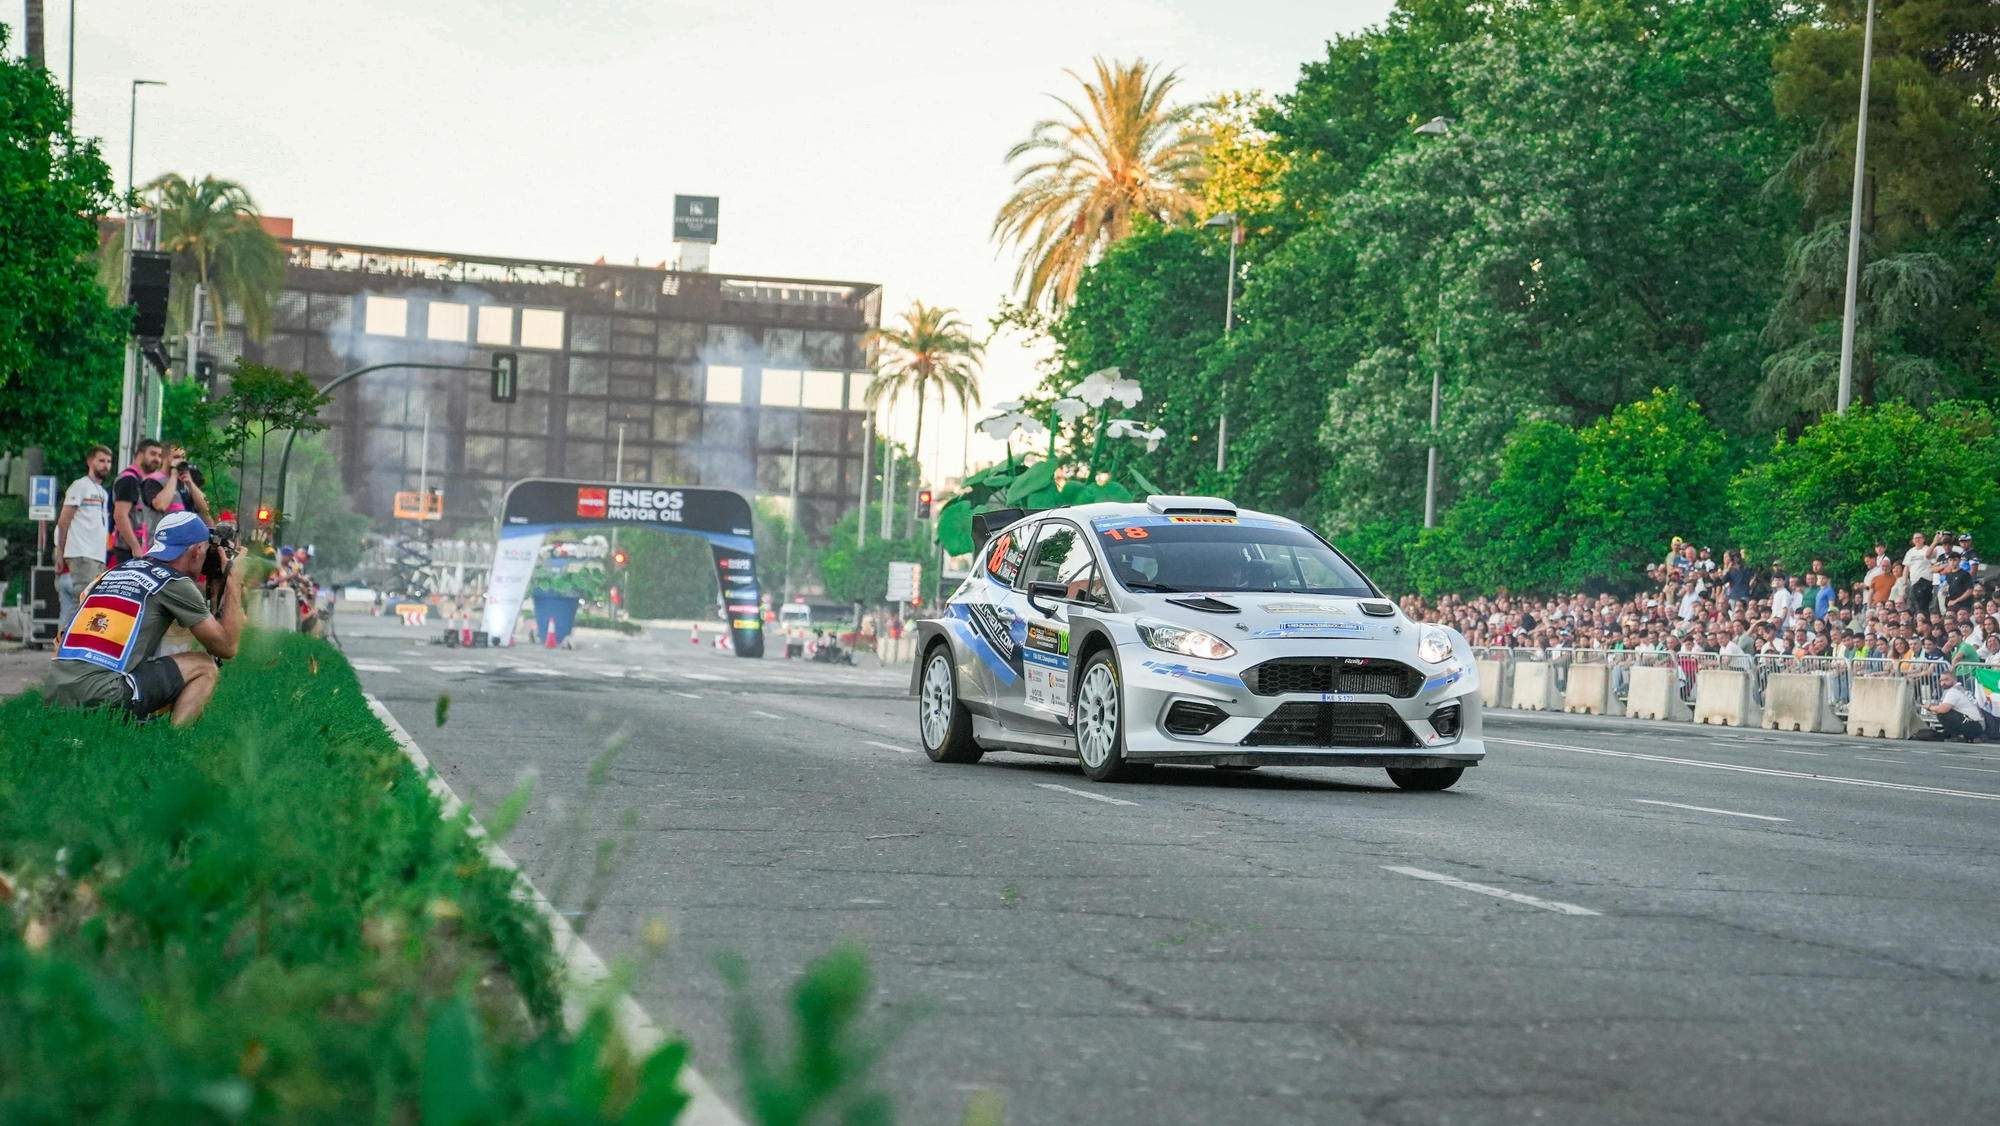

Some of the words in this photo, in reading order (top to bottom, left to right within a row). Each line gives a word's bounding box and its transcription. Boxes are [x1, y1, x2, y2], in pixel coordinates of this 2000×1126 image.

[608, 488, 684, 510] ENEOS
[607, 506, 658, 521] MOTOR
[660, 508, 683, 522] OIL
[1104, 526, 1149, 541] 18
[988, 533, 1011, 573] 18
[106, 570, 153, 590] PHOTOGRAPHER
[1060, 630, 1069, 654] 18
